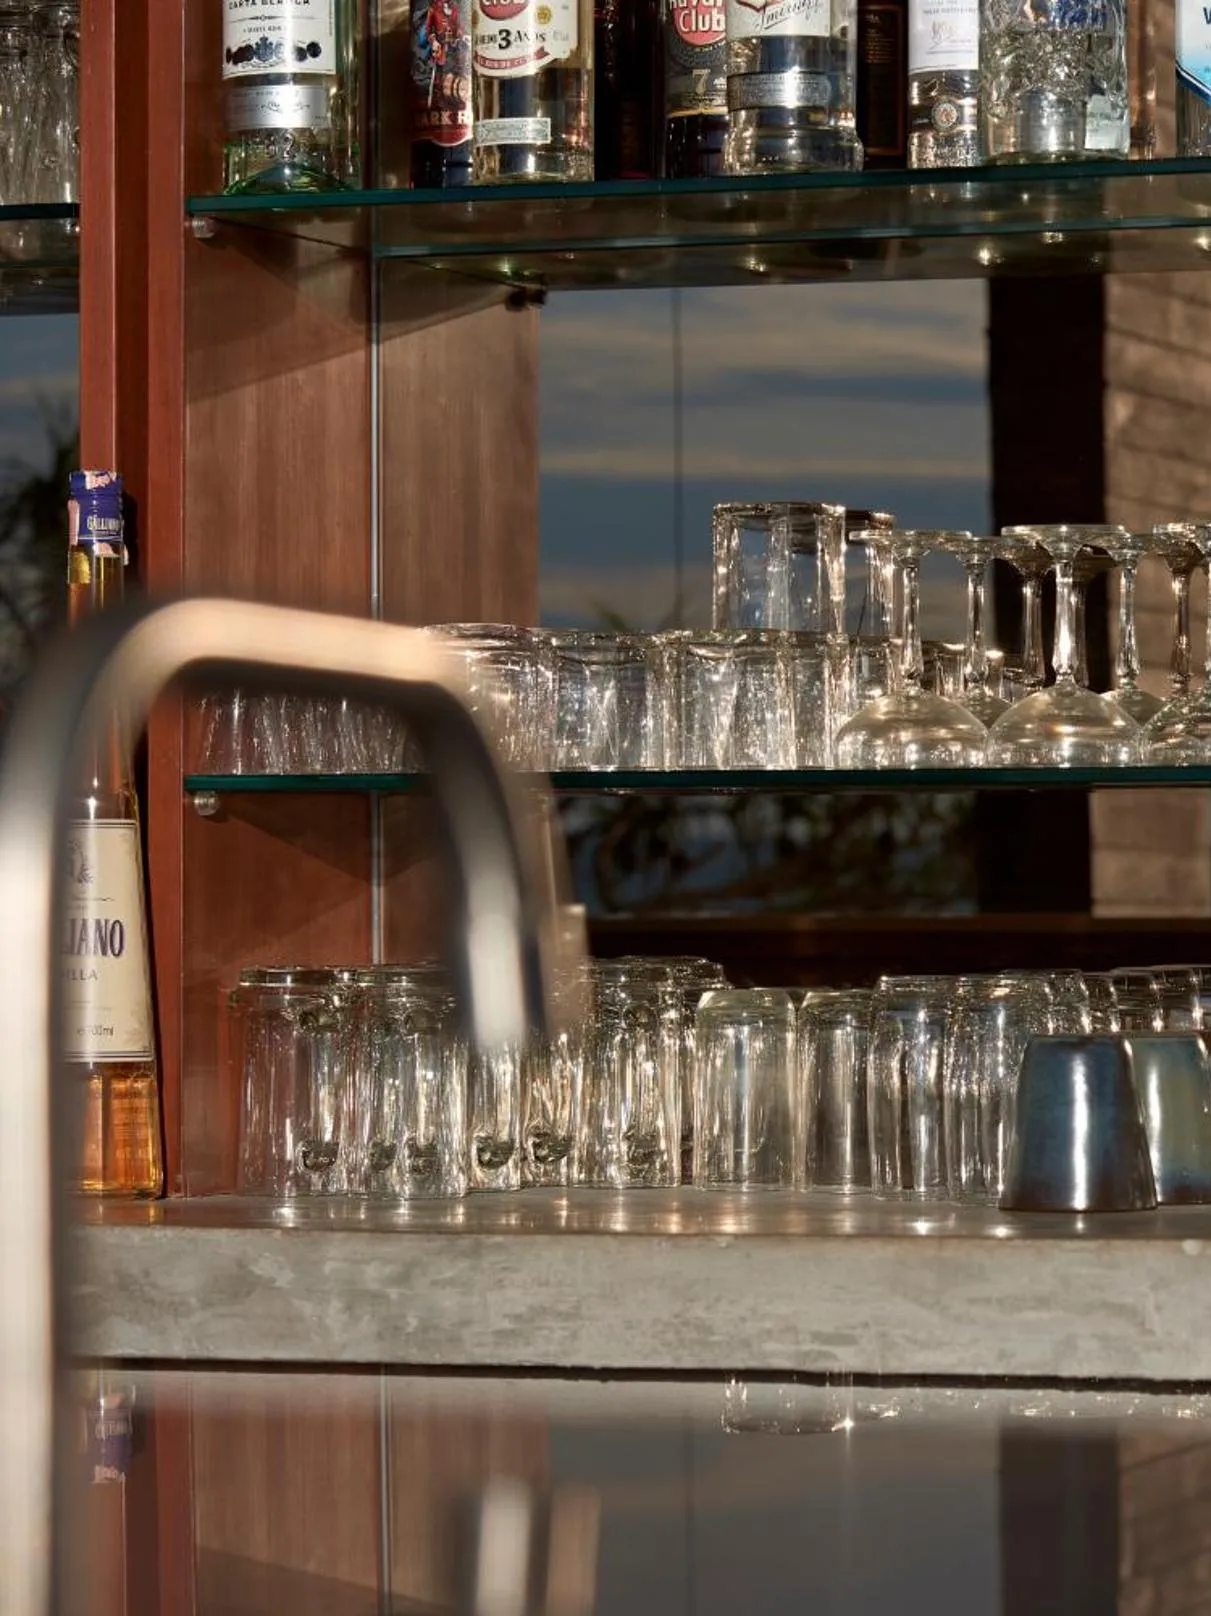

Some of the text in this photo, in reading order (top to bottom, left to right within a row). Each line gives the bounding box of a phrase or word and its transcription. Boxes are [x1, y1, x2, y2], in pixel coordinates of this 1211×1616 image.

[679, 7, 726, 32] Club
[498, 28, 512, 50] 3
[692, 68, 711, 97] 7
